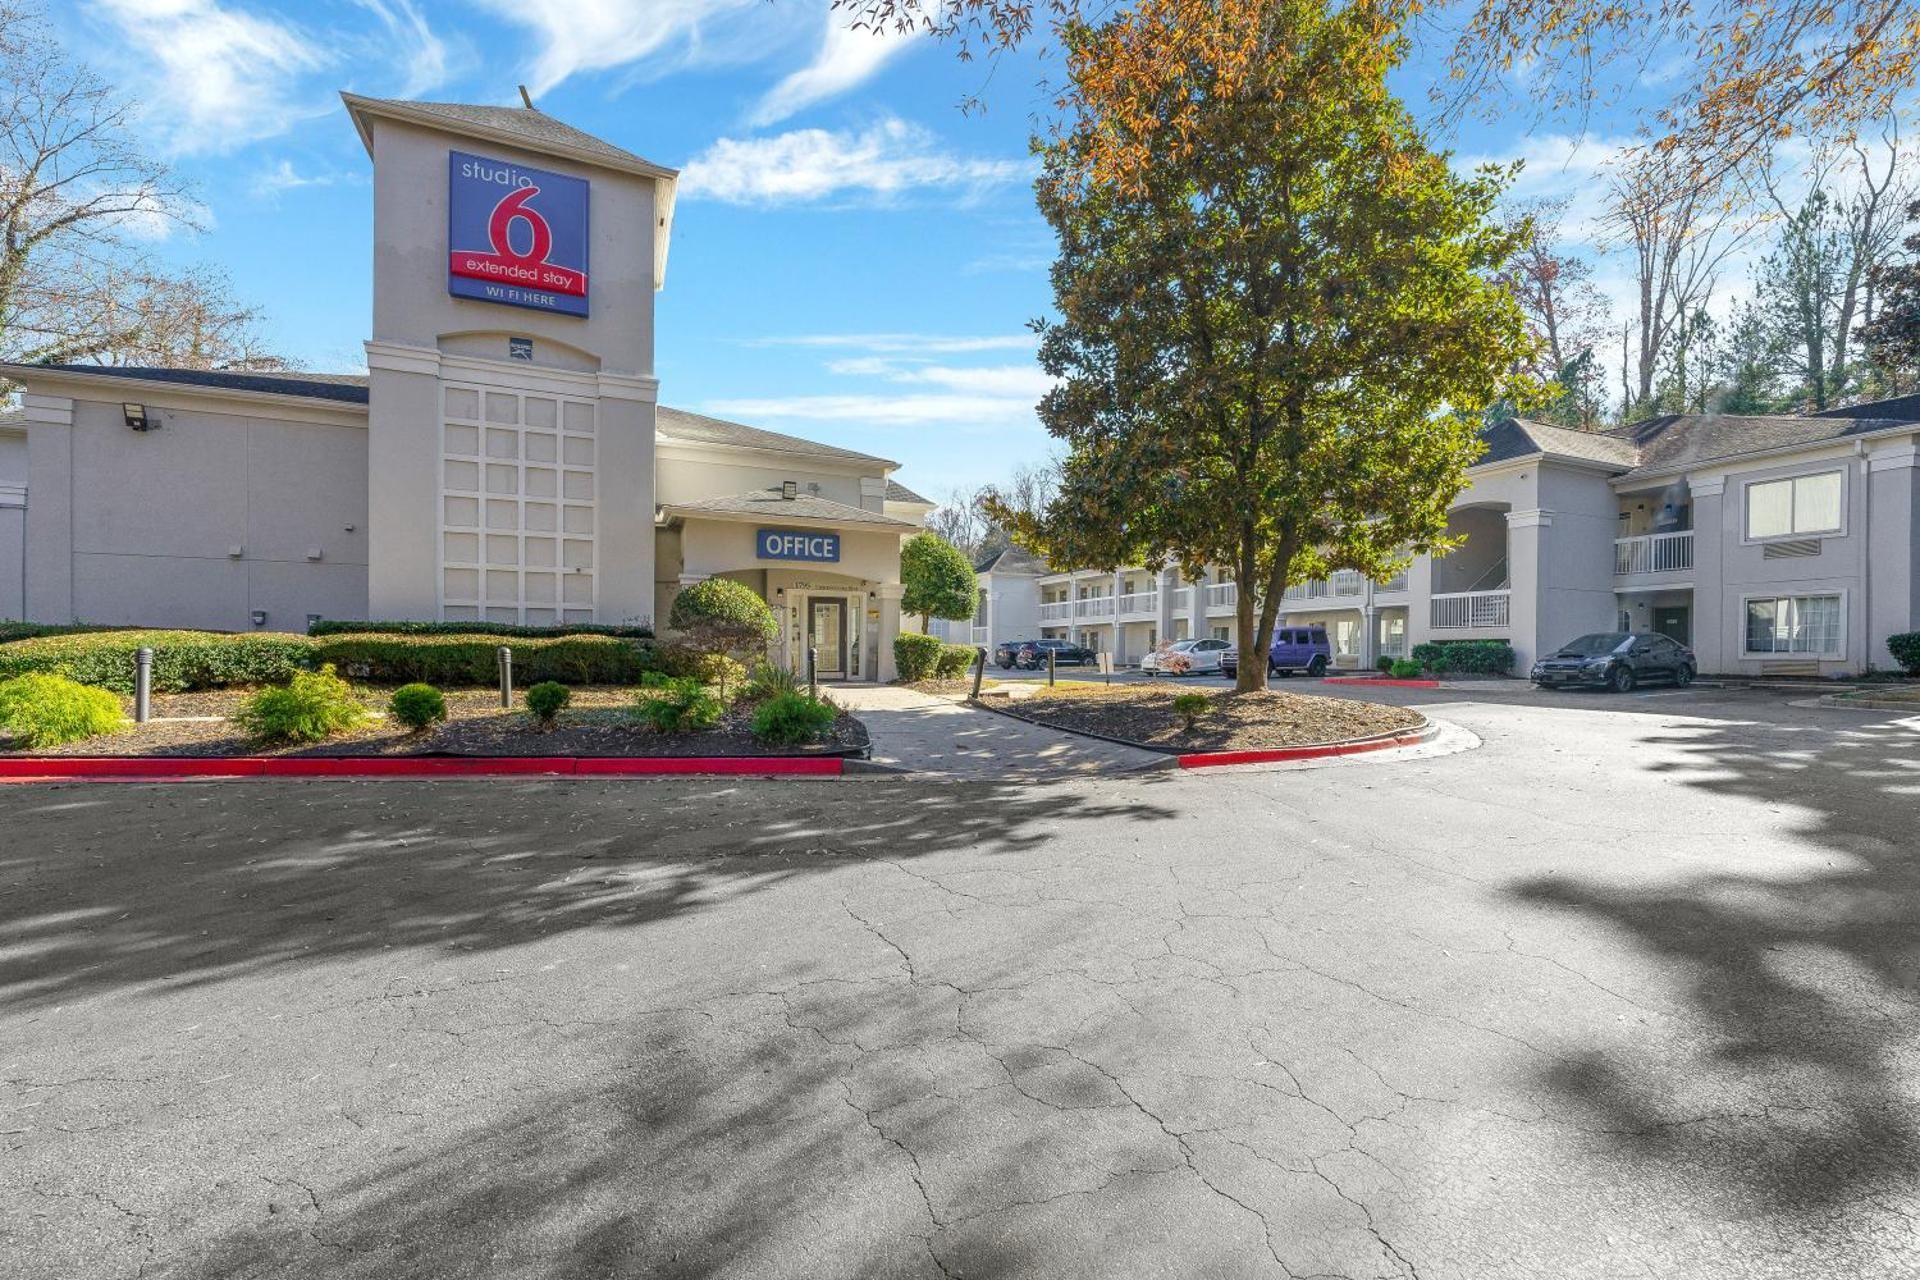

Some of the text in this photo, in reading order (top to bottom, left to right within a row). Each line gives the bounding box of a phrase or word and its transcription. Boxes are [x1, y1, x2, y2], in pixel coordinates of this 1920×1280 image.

[462, 161, 533, 188] studio
[488, 185, 553, 263] 6
[466, 259, 573, 289] extended stay
[524, 292, 556, 306] HERE
[766, 534, 834, 558] OFFICE
